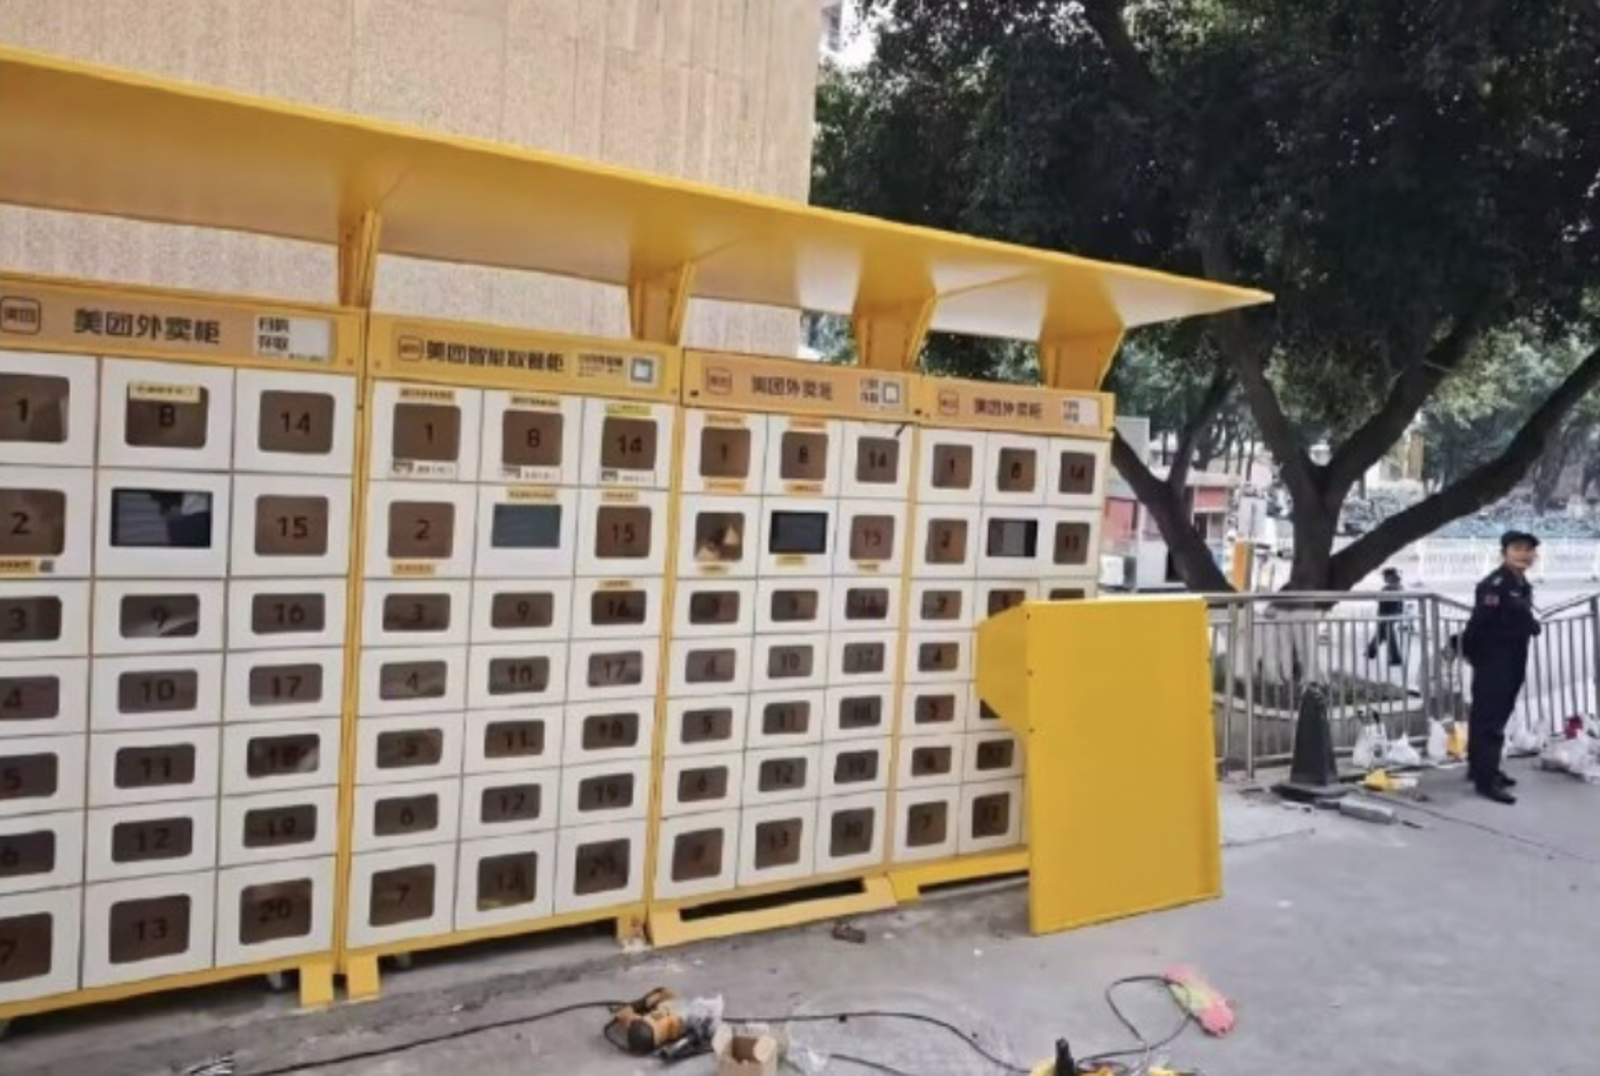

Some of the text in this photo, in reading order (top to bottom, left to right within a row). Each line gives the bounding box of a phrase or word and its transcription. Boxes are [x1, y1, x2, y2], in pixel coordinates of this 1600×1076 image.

[73, 307, 221, 344] 美团外卖柜
[16, 398, 28, 421] 1
[280, 411, 311, 435] 14
[425, 423, 434, 444] 1
[526, 427, 541, 448] 8
[617, 433, 642, 455] 14
[720, 443, 728, 463] 1
[868, 450, 887, 468] 14
[10, 511, 31, 536] 2
[275, 516, 309, 539] 15
[414, 518, 431, 541] 2
[611, 522, 636, 545] 15
[8, 606, 28, 634] 3
[152, 605, 170, 629] 9
[273, 603, 306, 625] 16
[411, 603, 424, 623] 3
[516, 600, 530, 620] 9
[405, 671, 419, 690] 4
[507, 664, 533, 684] 10
[604, 660, 627, 679] 17
[2, 687, 22, 709] 4
[140, 679, 175, 703] 10
[270, 675, 303, 698] 17
[3, 765, 23, 790] 5
[139, 756, 172, 780] 11
[266, 816, 297, 839] 19
[135, 827, 171, 852] 12
[259, 898, 292, 924] 20
[133, 917, 168, 942] 13
